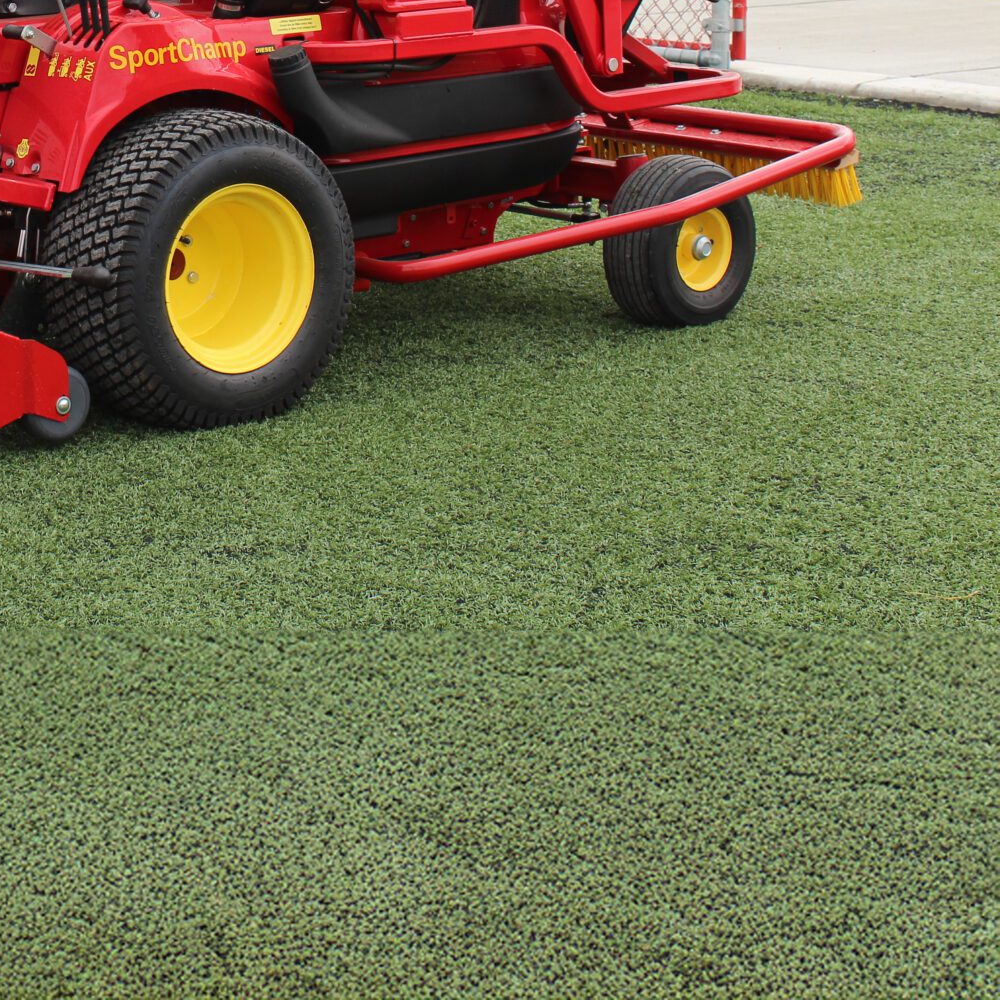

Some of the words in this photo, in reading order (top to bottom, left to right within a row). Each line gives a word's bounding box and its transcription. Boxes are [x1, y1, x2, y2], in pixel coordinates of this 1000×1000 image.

[109, 37, 247, 74] SportChamp
[255, 46, 276, 54] DIESEL
[83, 61, 96, 81] AUX
